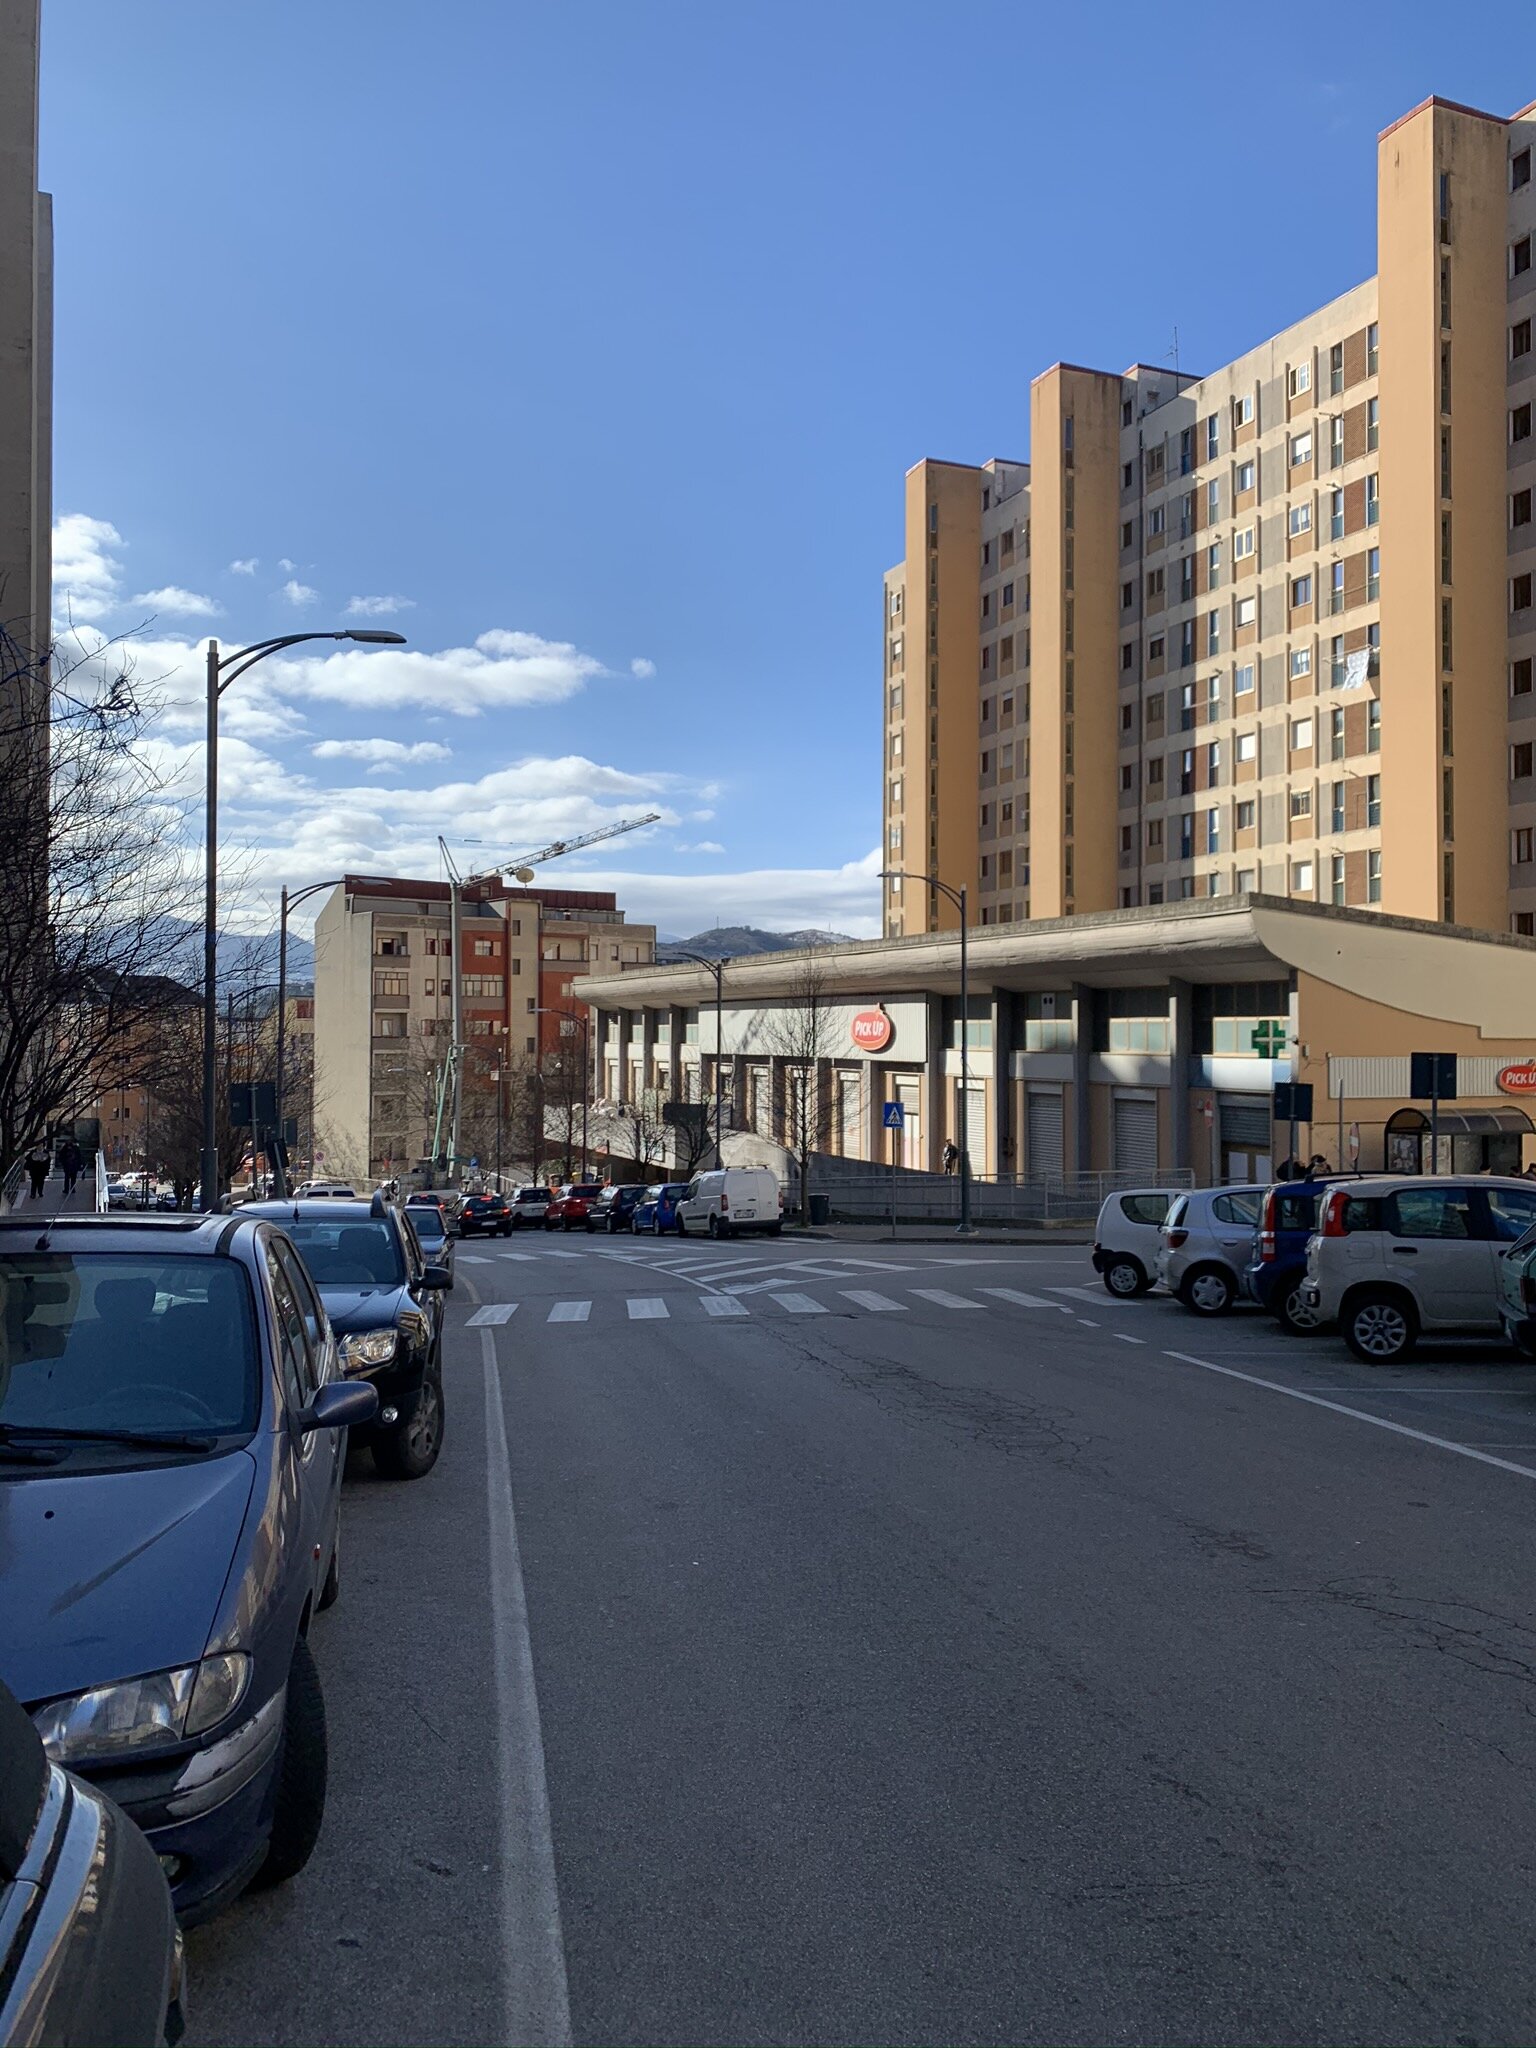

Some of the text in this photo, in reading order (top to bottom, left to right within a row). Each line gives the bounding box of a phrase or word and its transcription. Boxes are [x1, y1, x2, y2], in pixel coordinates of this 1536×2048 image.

[855, 1020, 884, 1037] PICK UP
[1528, 1071, 1536, 1084] U
